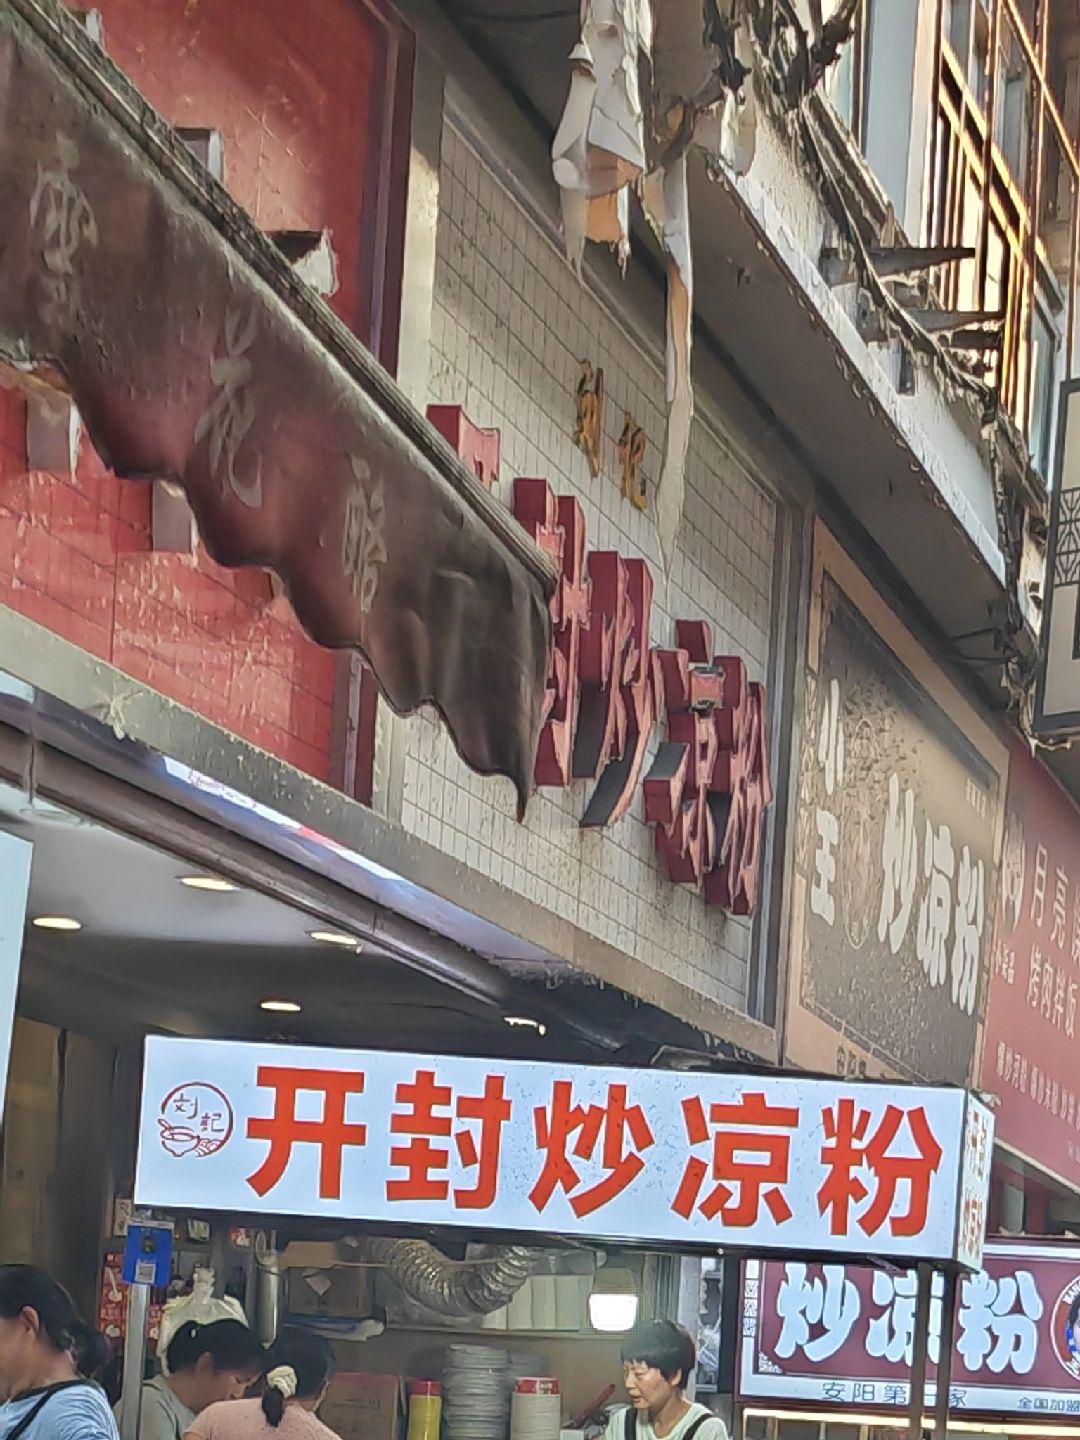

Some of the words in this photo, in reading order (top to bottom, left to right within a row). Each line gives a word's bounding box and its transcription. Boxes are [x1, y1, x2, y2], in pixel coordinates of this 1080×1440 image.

[879, 774, 985, 1015] 炒凉粉
[246, 1066, 944, 1238] 开封炒凉粉
